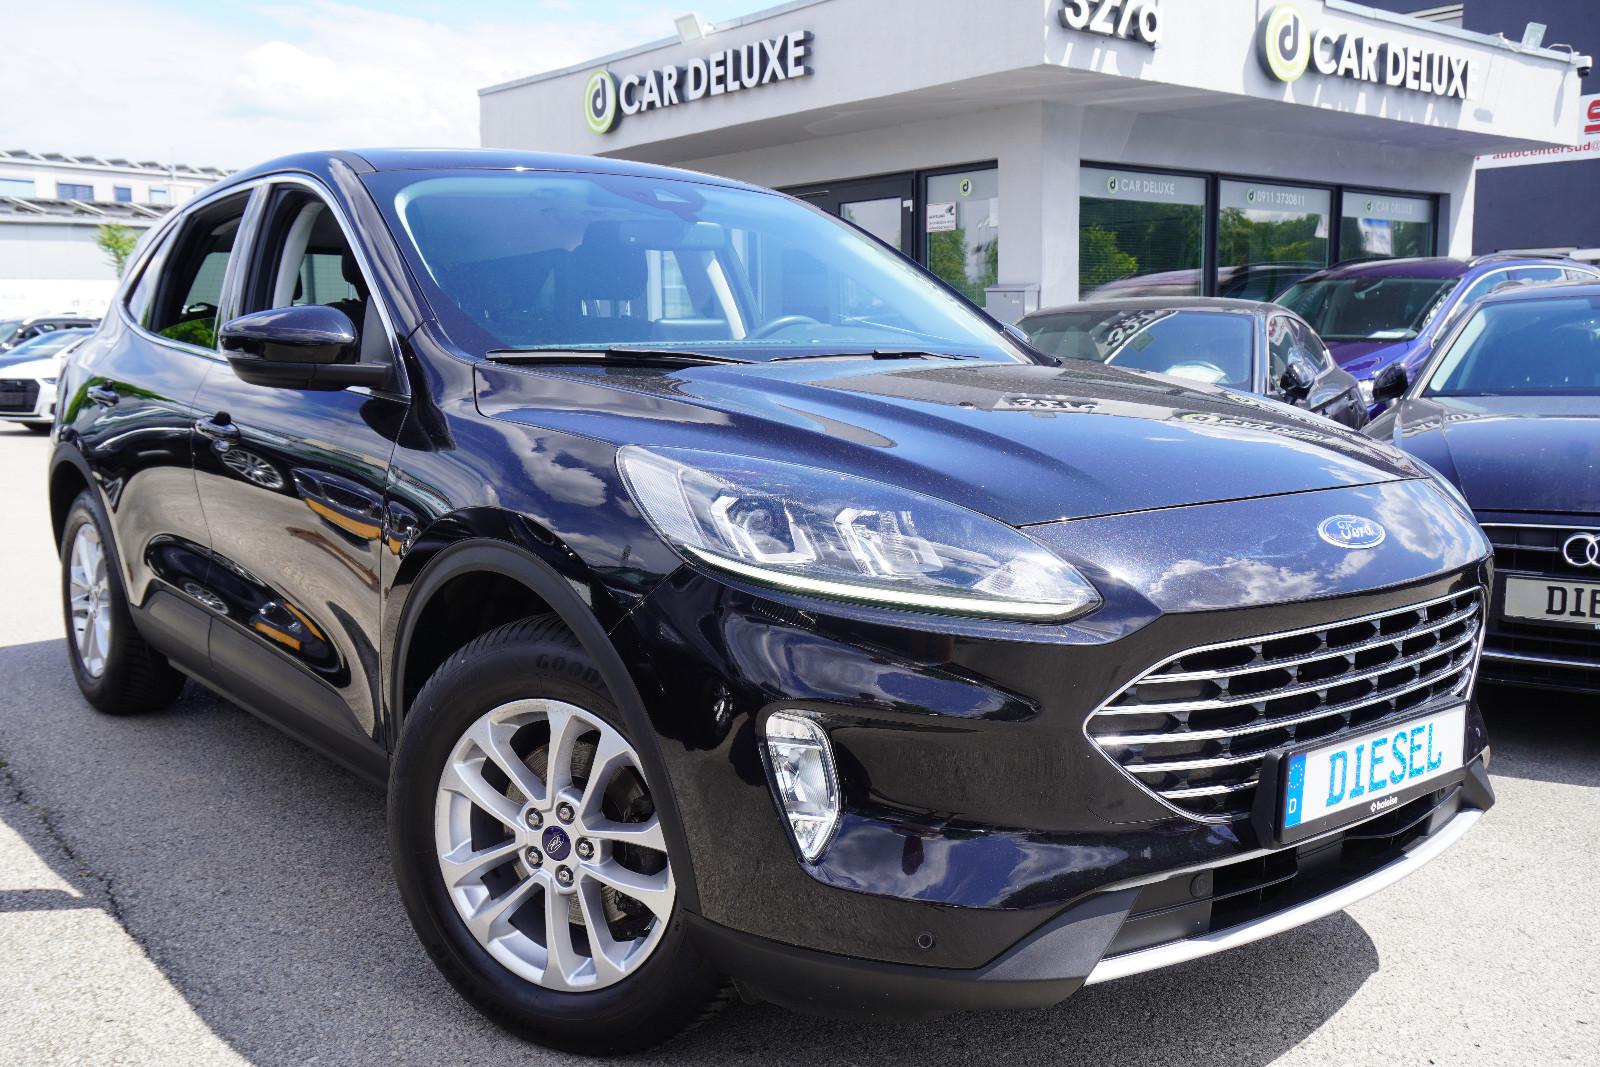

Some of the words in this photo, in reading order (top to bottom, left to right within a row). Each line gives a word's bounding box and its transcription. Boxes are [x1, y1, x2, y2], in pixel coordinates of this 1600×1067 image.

[619, 65, 679, 115] CAR
[687, 30, 806, 100] DELUXE
[1313, 28, 1379, 82] CAR
[1387, 41, 1479, 100] DELUXE
[1120, 178, 1141, 192] CAR
[1143, 180, 1175, 195] DELUXE
[1337, 519, 1374, 540] Ford
[1326, 722, 1442, 807] DIESEL
[1288, 797, 1296, 815] D
